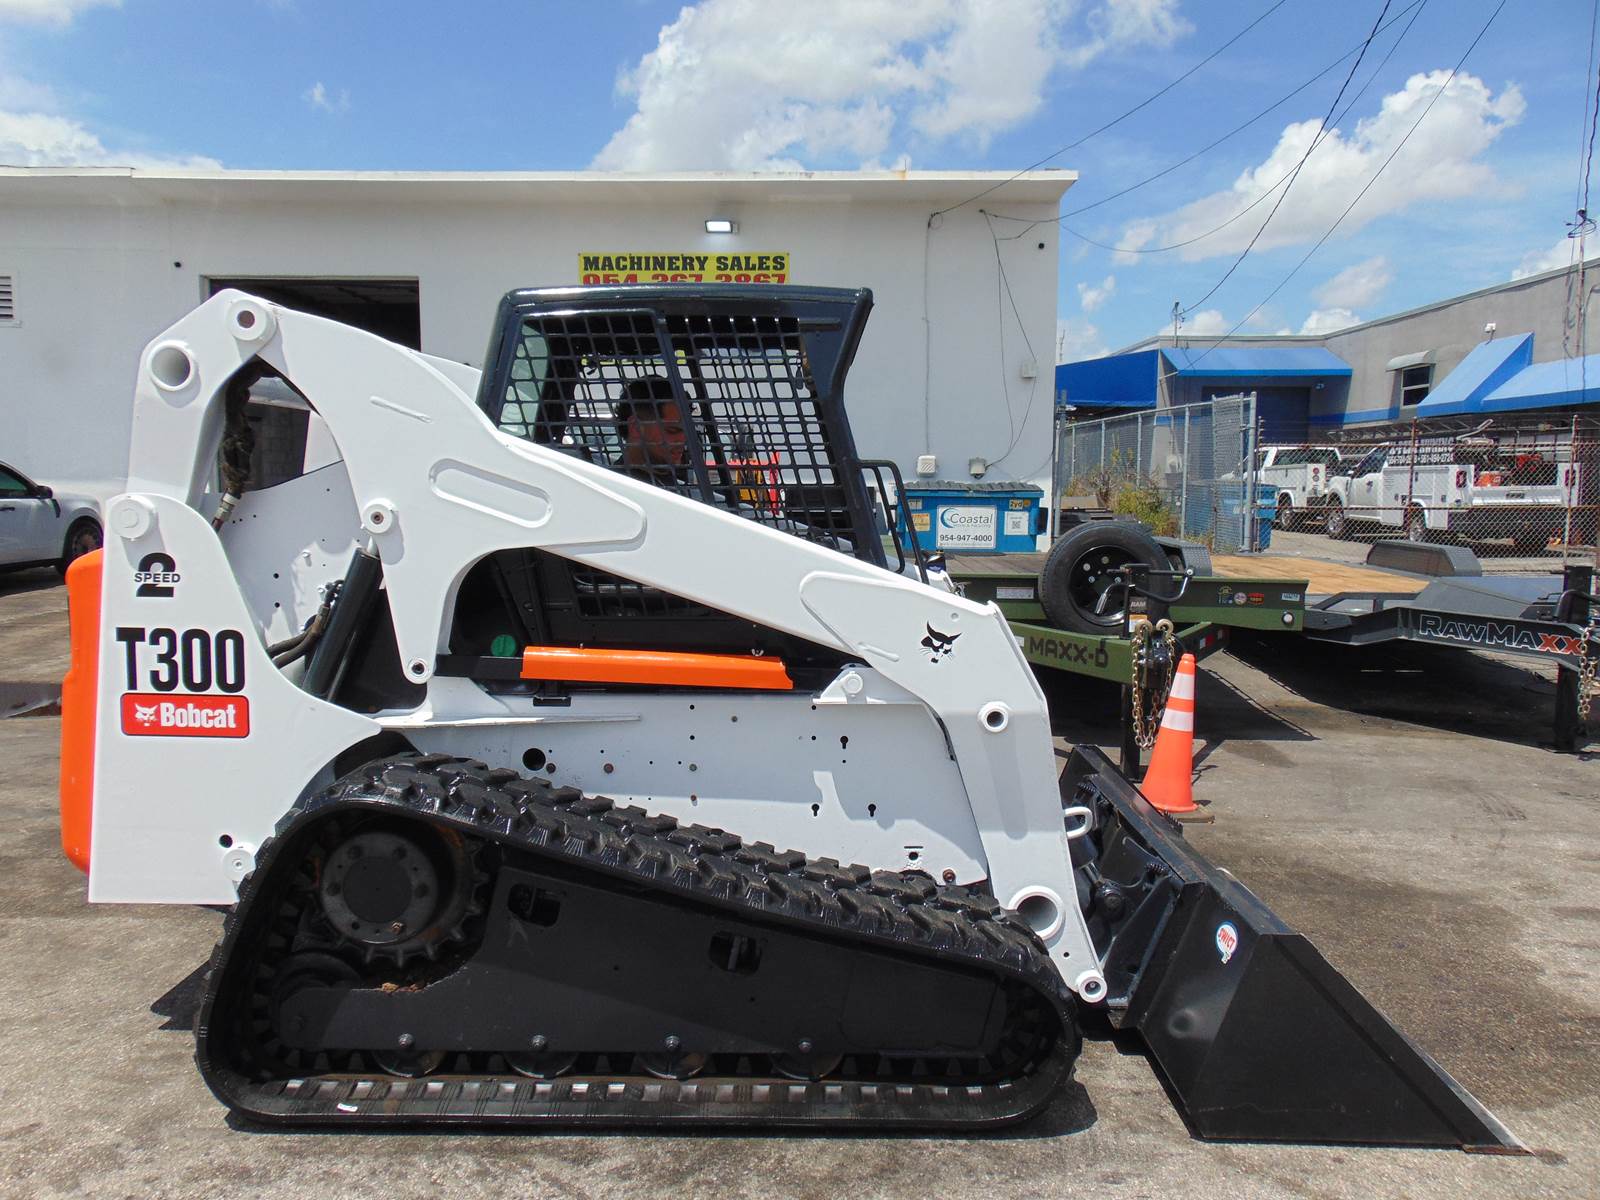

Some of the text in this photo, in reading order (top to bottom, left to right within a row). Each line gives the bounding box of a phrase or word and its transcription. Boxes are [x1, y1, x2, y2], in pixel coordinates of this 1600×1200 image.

[583, 256, 786, 271] MACHINERY SALES
[950, 513, 993, 524] Coastal
[940, 534, 993, 542] 954-947-4000
[134, 573, 181, 583] SPEED
[116, 627, 245, 693] T300
[160, 703, 237, 728] Bobcat
